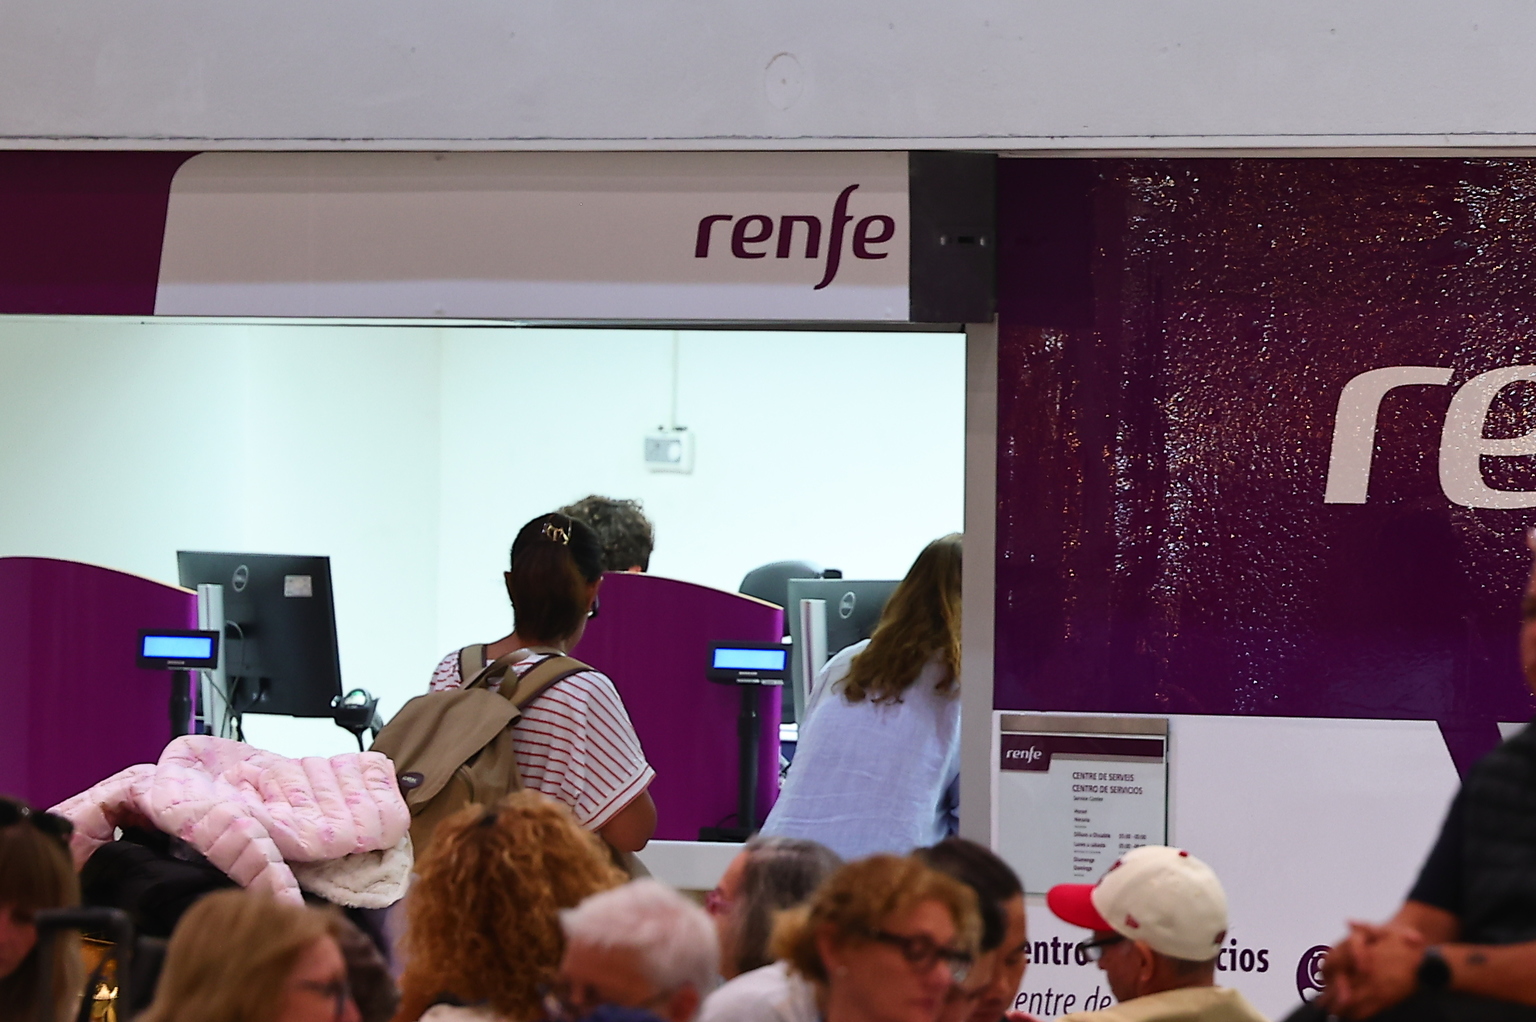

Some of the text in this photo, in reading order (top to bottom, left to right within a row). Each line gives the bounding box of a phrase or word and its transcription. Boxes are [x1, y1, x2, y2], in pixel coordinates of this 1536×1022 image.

[694, 183, 896, 291] renfe
[1006, 745, 1043, 764] renfe
[1098, 772, 1108, 781] DE
[1099, 785, 1109, 794] DE
[1014, 987, 1076, 1016] entre
